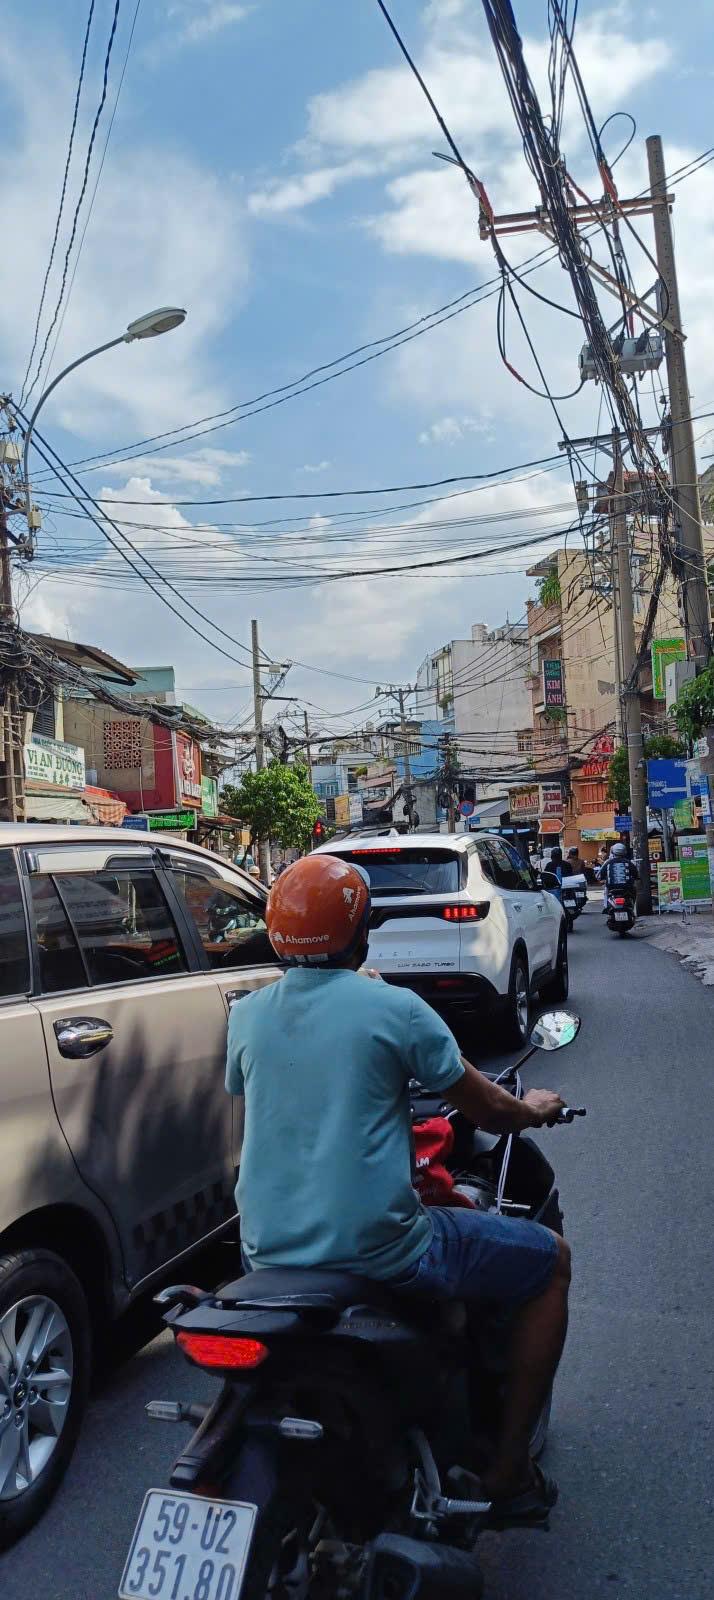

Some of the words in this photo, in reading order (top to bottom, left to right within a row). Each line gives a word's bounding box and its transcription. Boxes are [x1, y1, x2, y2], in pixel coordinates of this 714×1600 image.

[546, 680, 560, 689] KIM
[546, 692, 562, 704] ÁNH
[40, 752, 53, 768] AN
[285, 934, 330, 945] Ahamove
[153, 1499, 237, 1554] 59-U2
